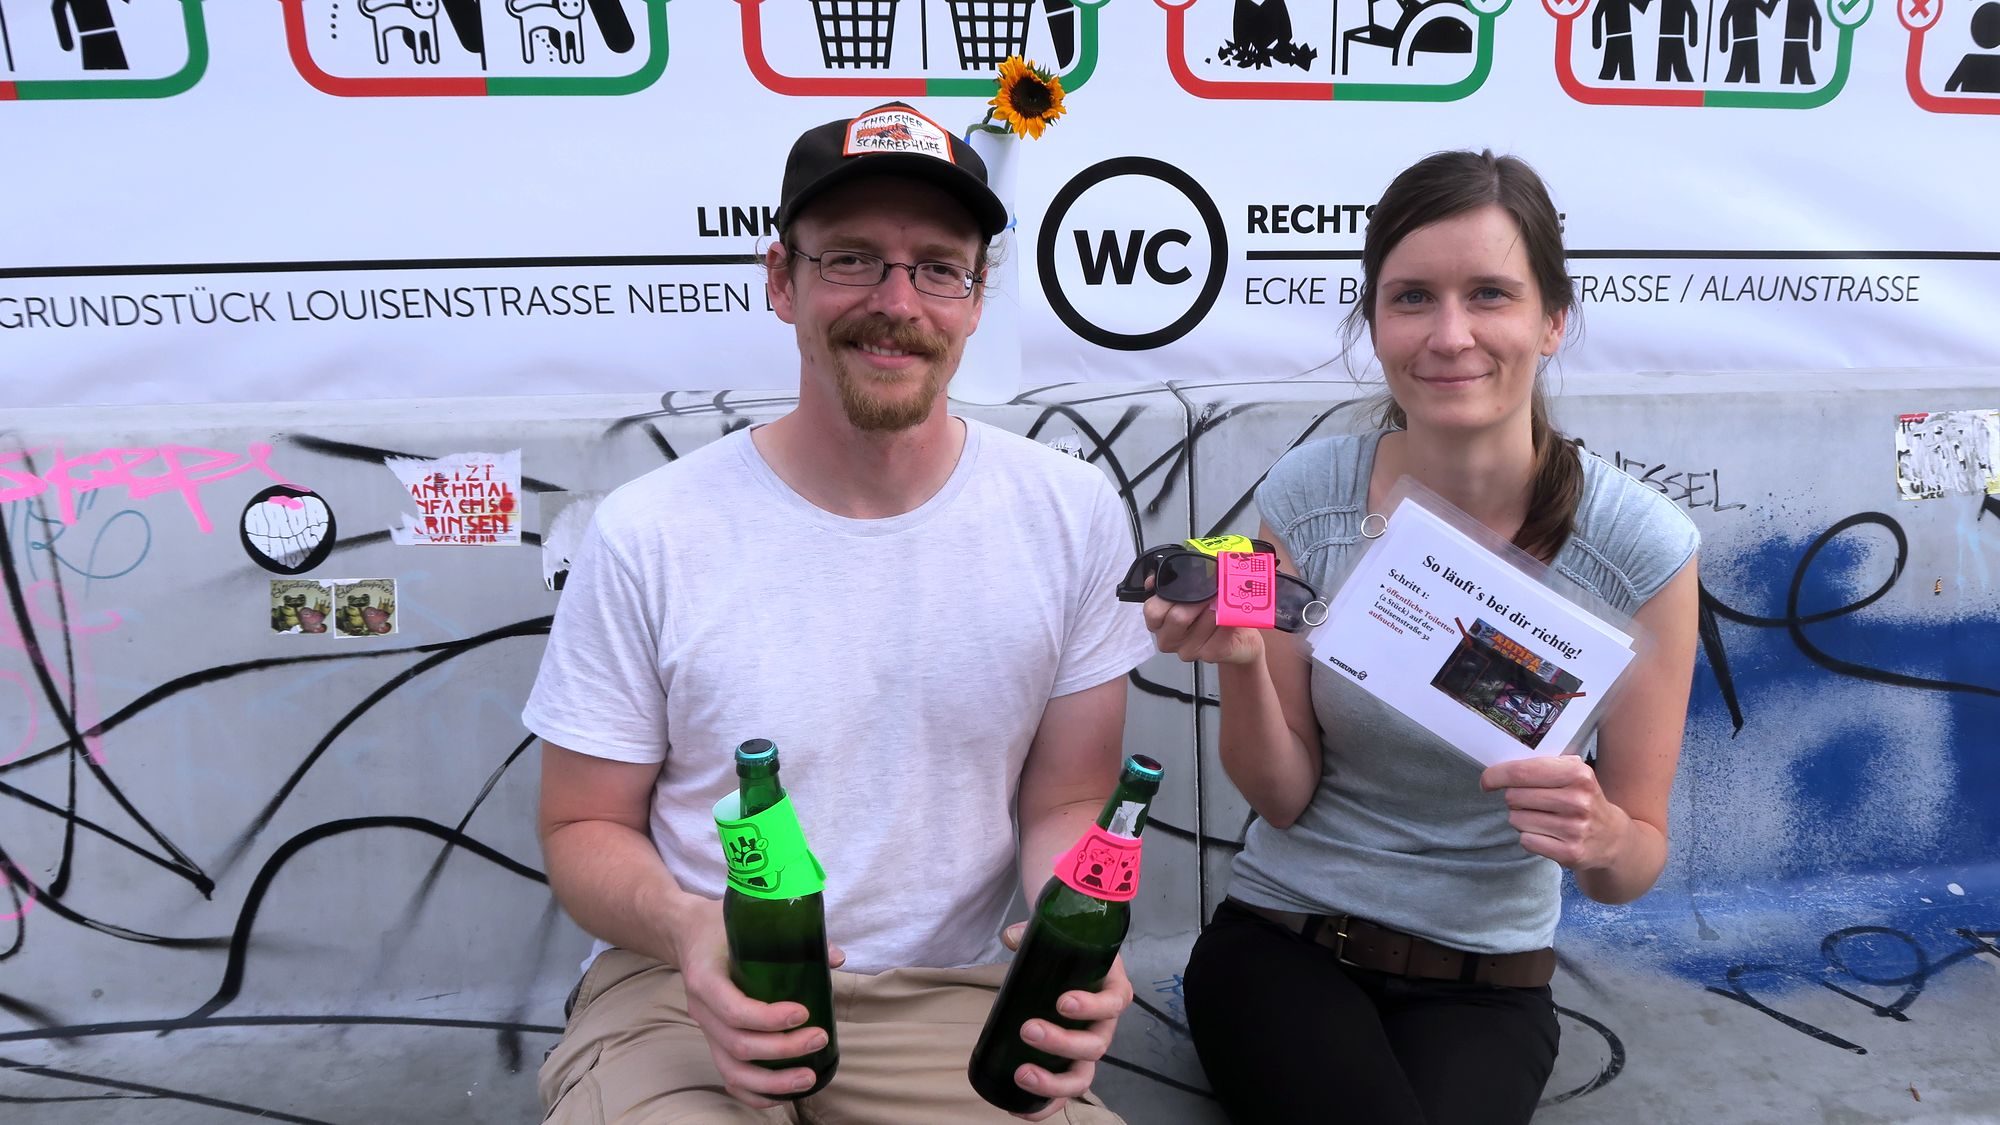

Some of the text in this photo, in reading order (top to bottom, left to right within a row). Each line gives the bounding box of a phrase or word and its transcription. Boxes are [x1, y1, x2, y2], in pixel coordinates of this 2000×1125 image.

[861, 114, 923, 128] THRASHER
[1073, 228, 1193, 285] WC
[1246, 278, 1326, 305] ECKE
[1700, 275, 1920, 302] ALAUNSTRASSE
[0, 286, 276, 329] GRUNDSTÜCK
[287, 284, 615, 321] LOUISENSTRASSE
[628, 283, 750, 313] NEBEN
[1388, 568, 1430, 600] Schritt 1:
[1368, 609, 1404, 635] aufsuchen
[1374, 601, 1422, 636] Louisenstraße
[1386, 587, 1456, 635] öffentliche Toiletten
[1386, 598, 1410, 616] Stück)
[1409, 613, 1423, 624] auf
[1421, 620, 1435, 632] der
[1422, 555, 1441, 573] So
[1486, 595, 1510, 616] bei
[1509, 610, 1531, 630] dir
[1531, 626, 1583, 660] richtig!
[1329, 656, 1358, 677] SCHEUNE
